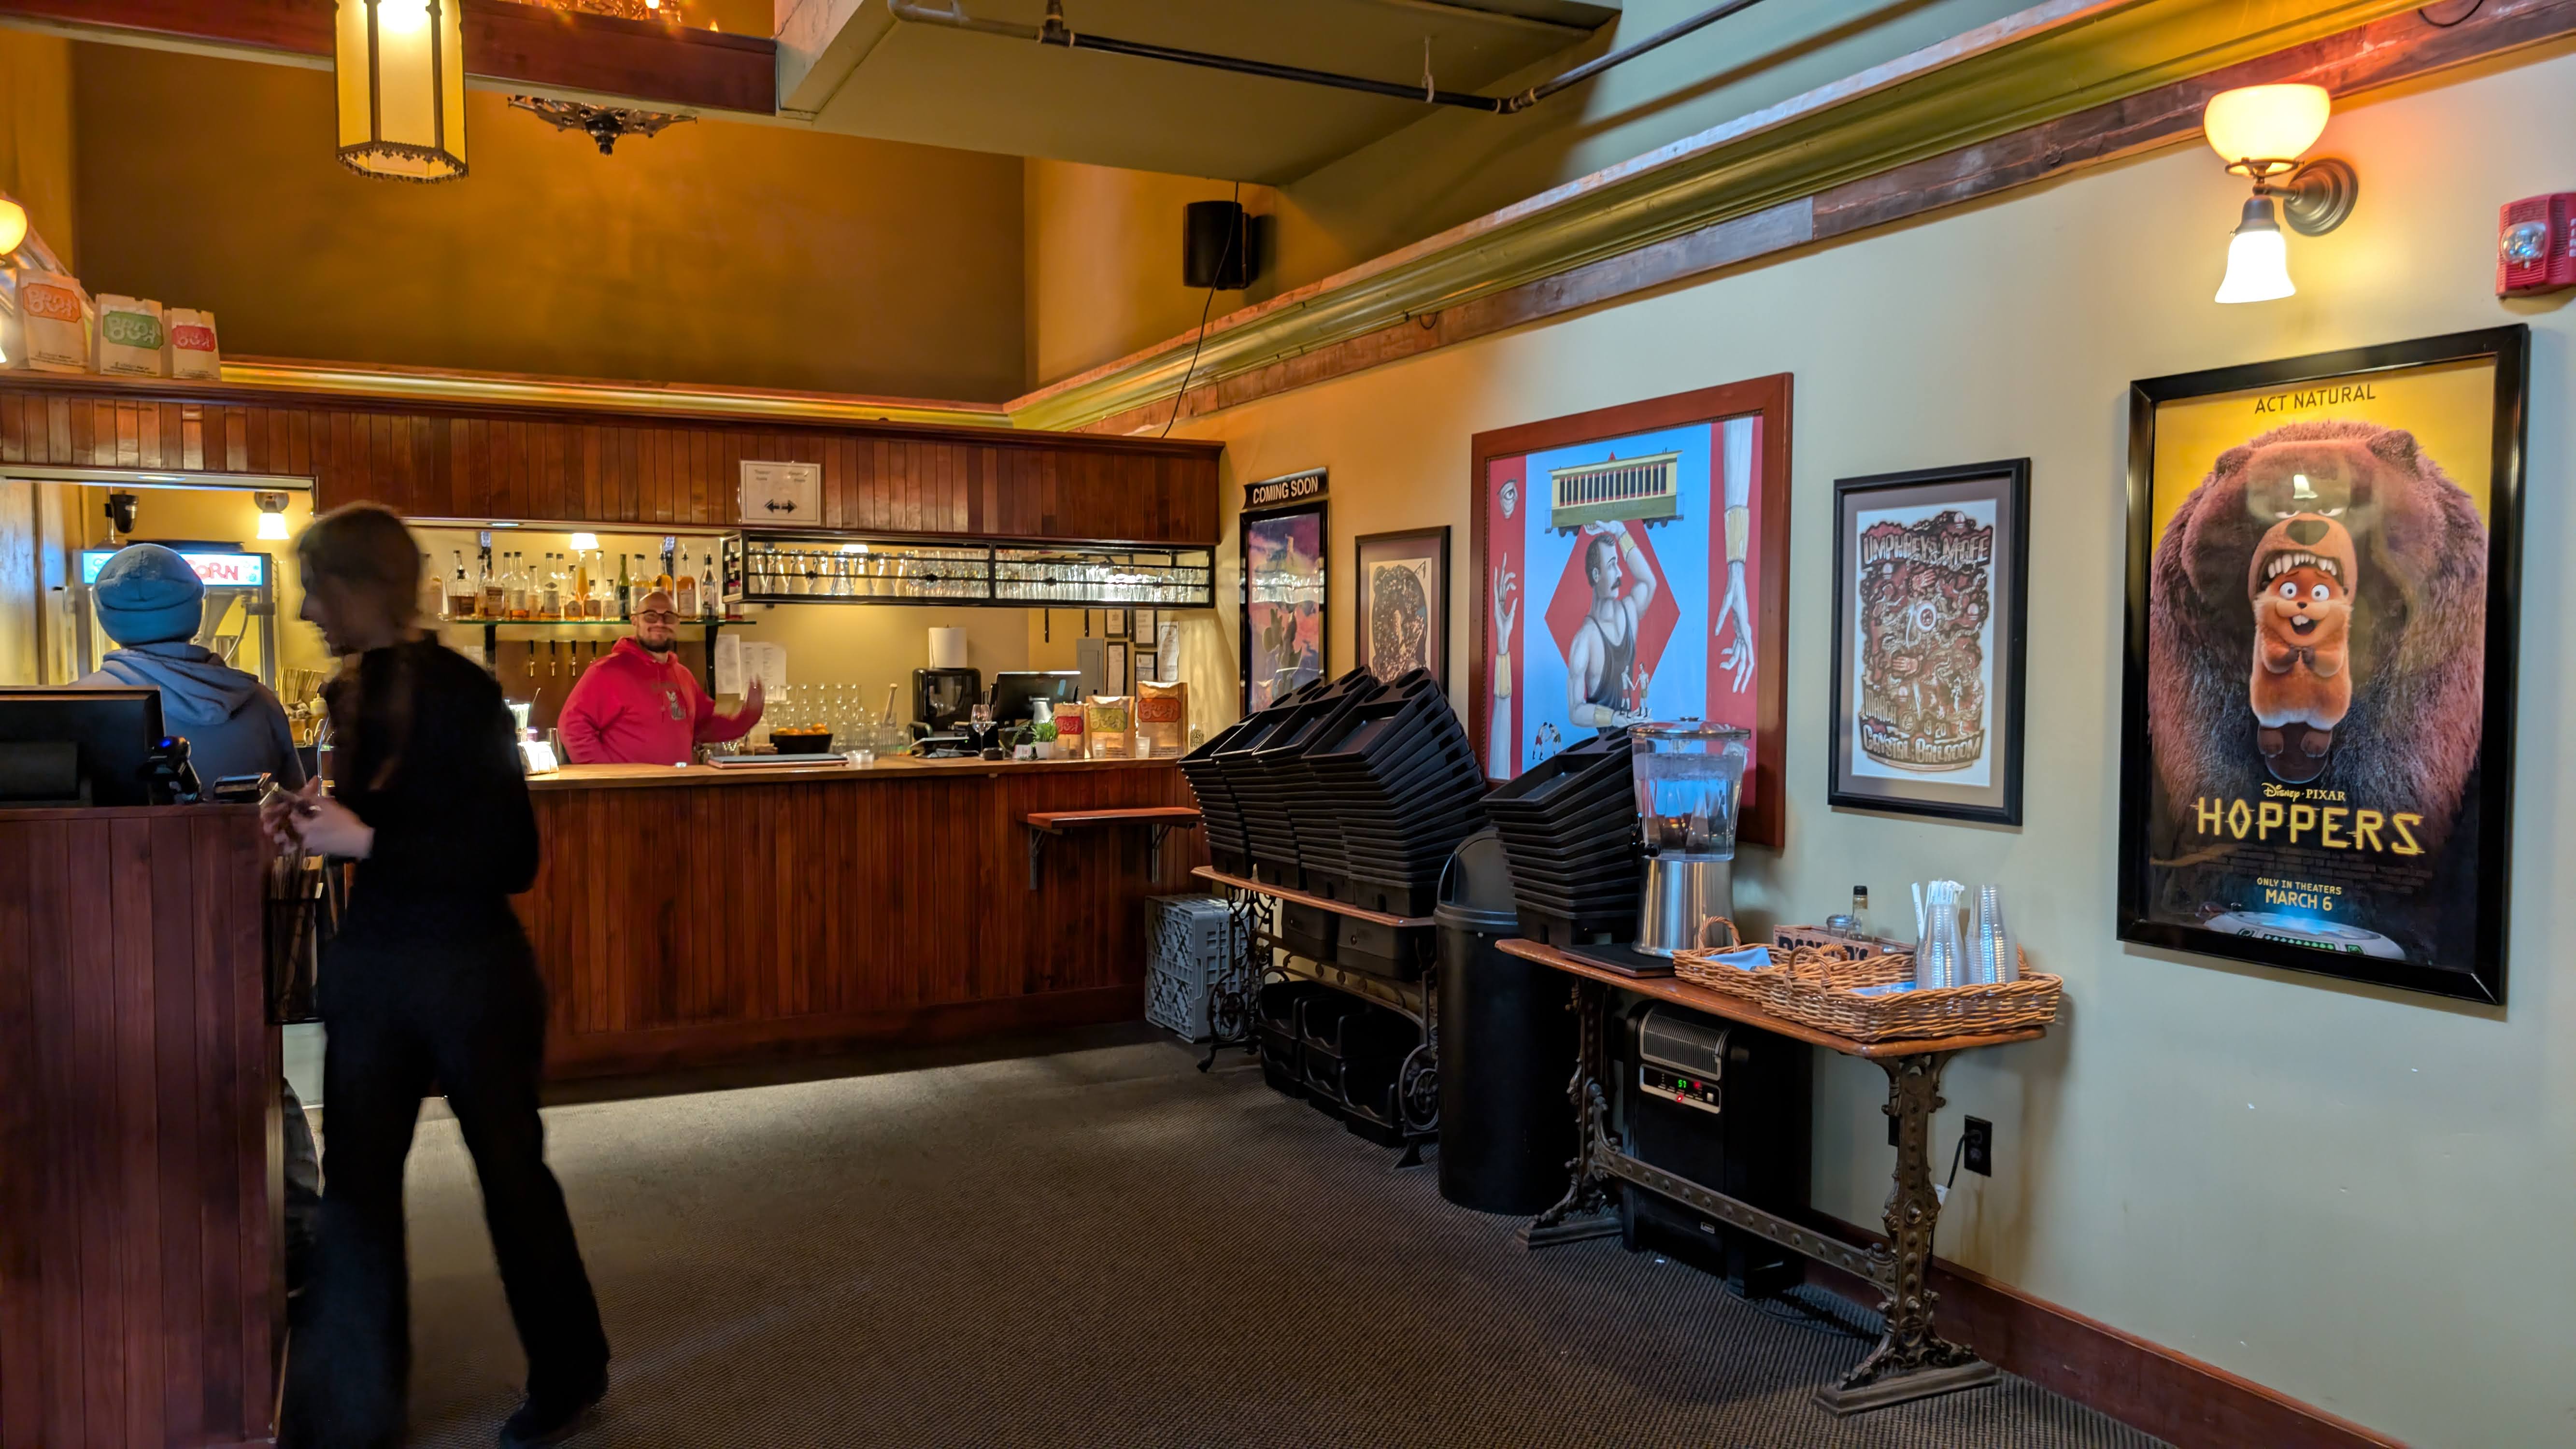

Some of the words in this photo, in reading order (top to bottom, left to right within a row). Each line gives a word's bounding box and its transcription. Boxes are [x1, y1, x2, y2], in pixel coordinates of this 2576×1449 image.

[2255, 395, 2287, 414] ACT
[2294, 384, 2376, 409] NATURAL
[1253, 482, 1289, 504] COMING
[1291, 475, 1318, 497] SOON
[1863, 724, 1910, 760] CRYSTAL
[1915, 737, 1980, 763] BALLROOM
[2305, 789, 2346, 802] PIXAR
[2197, 796, 2421, 855] HOPPERS
[2257, 877, 2279, 887] ONLY
[2281, 880, 2292, 889] IN
[2295, 881, 2342, 895] THEATERS
[2265, 888, 2318, 909] MARCH
[2322, 896, 2333, 911] 6
